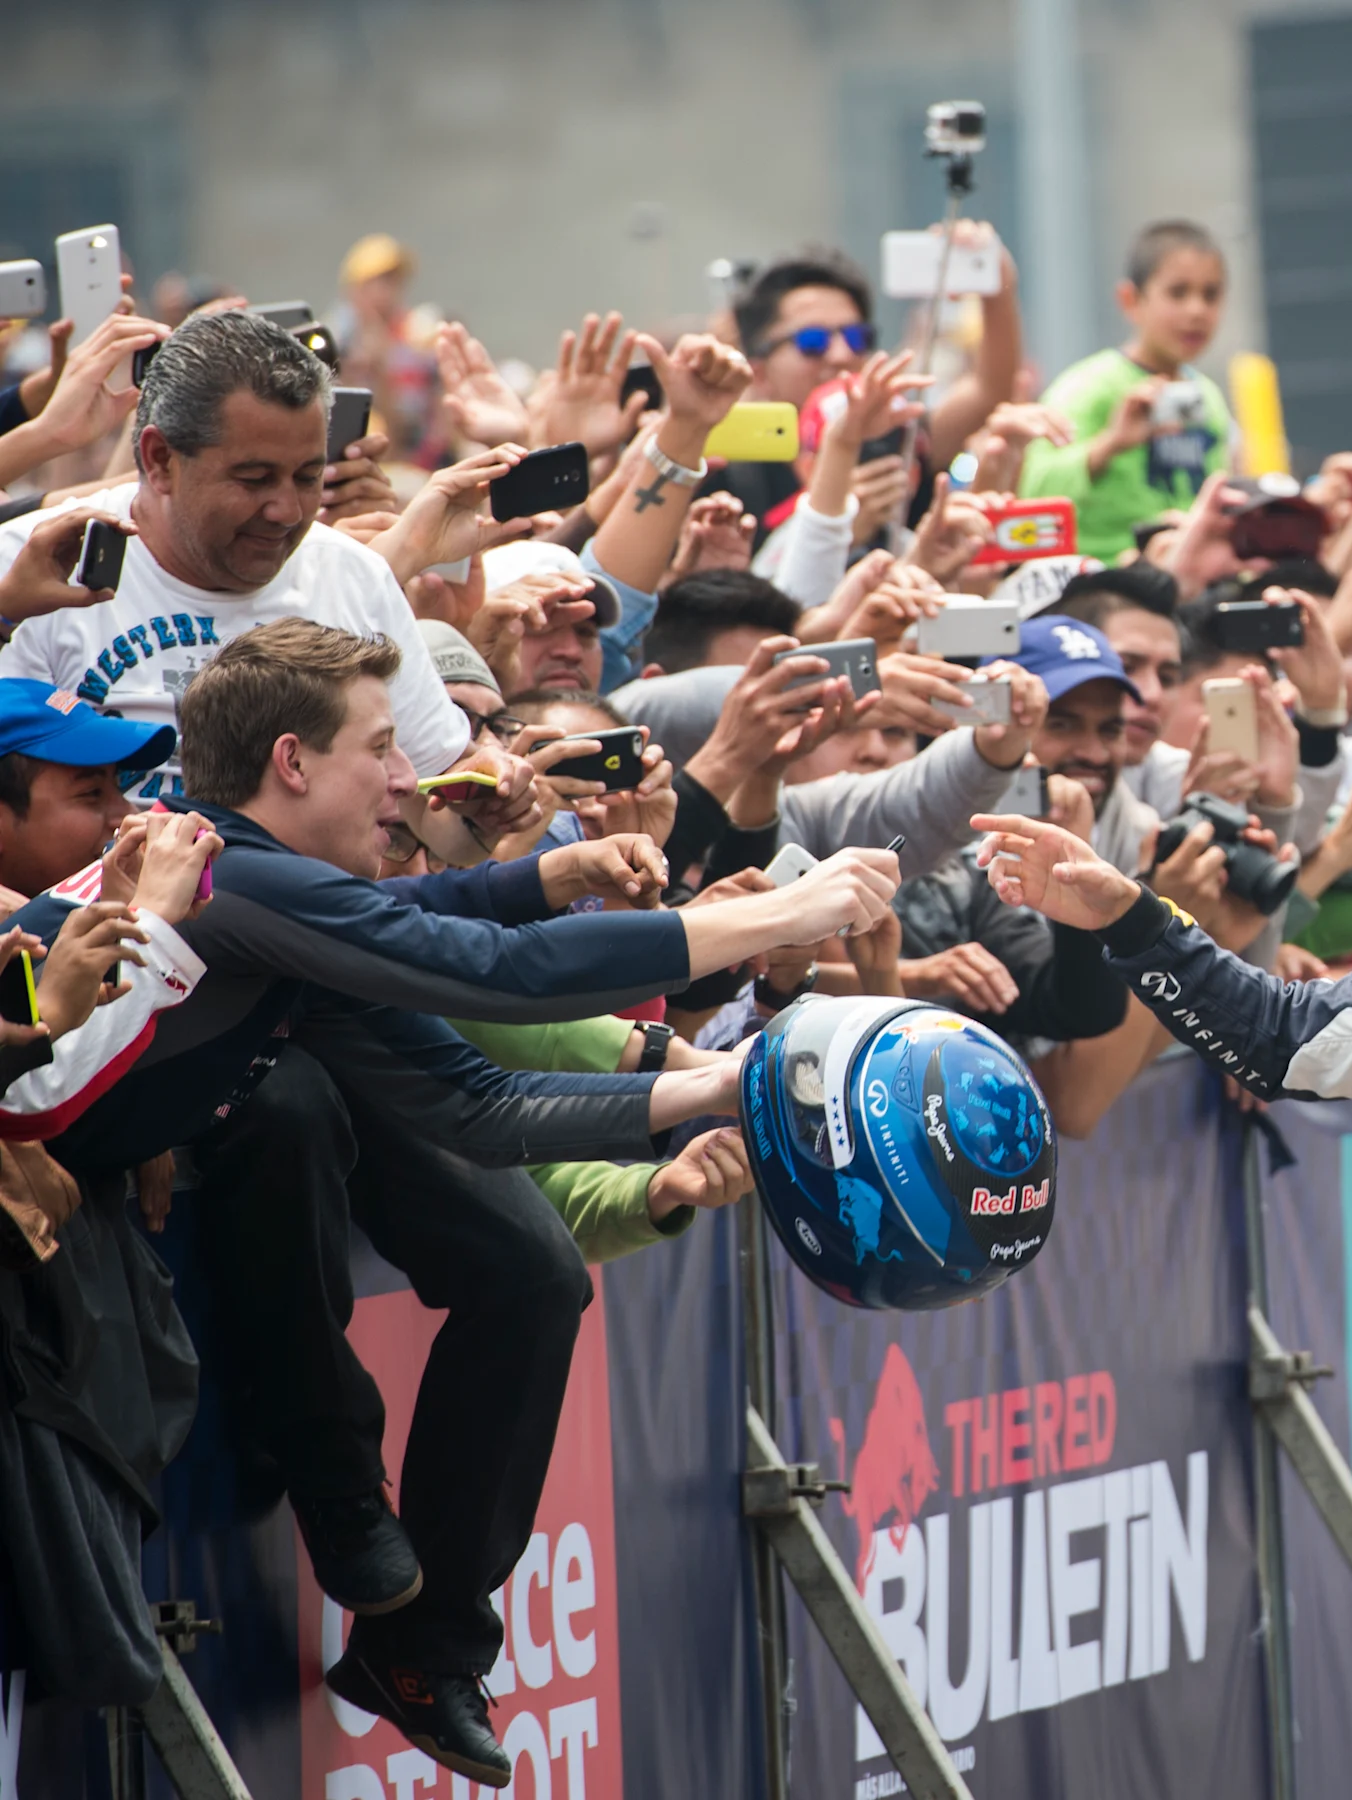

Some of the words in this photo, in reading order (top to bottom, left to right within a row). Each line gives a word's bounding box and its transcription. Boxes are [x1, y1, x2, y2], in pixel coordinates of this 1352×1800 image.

[879, 1123, 909, 1186] INFINITI
[970, 1186, 1017, 1215] Red
[1019, 1178, 1050, 1213] Bull
